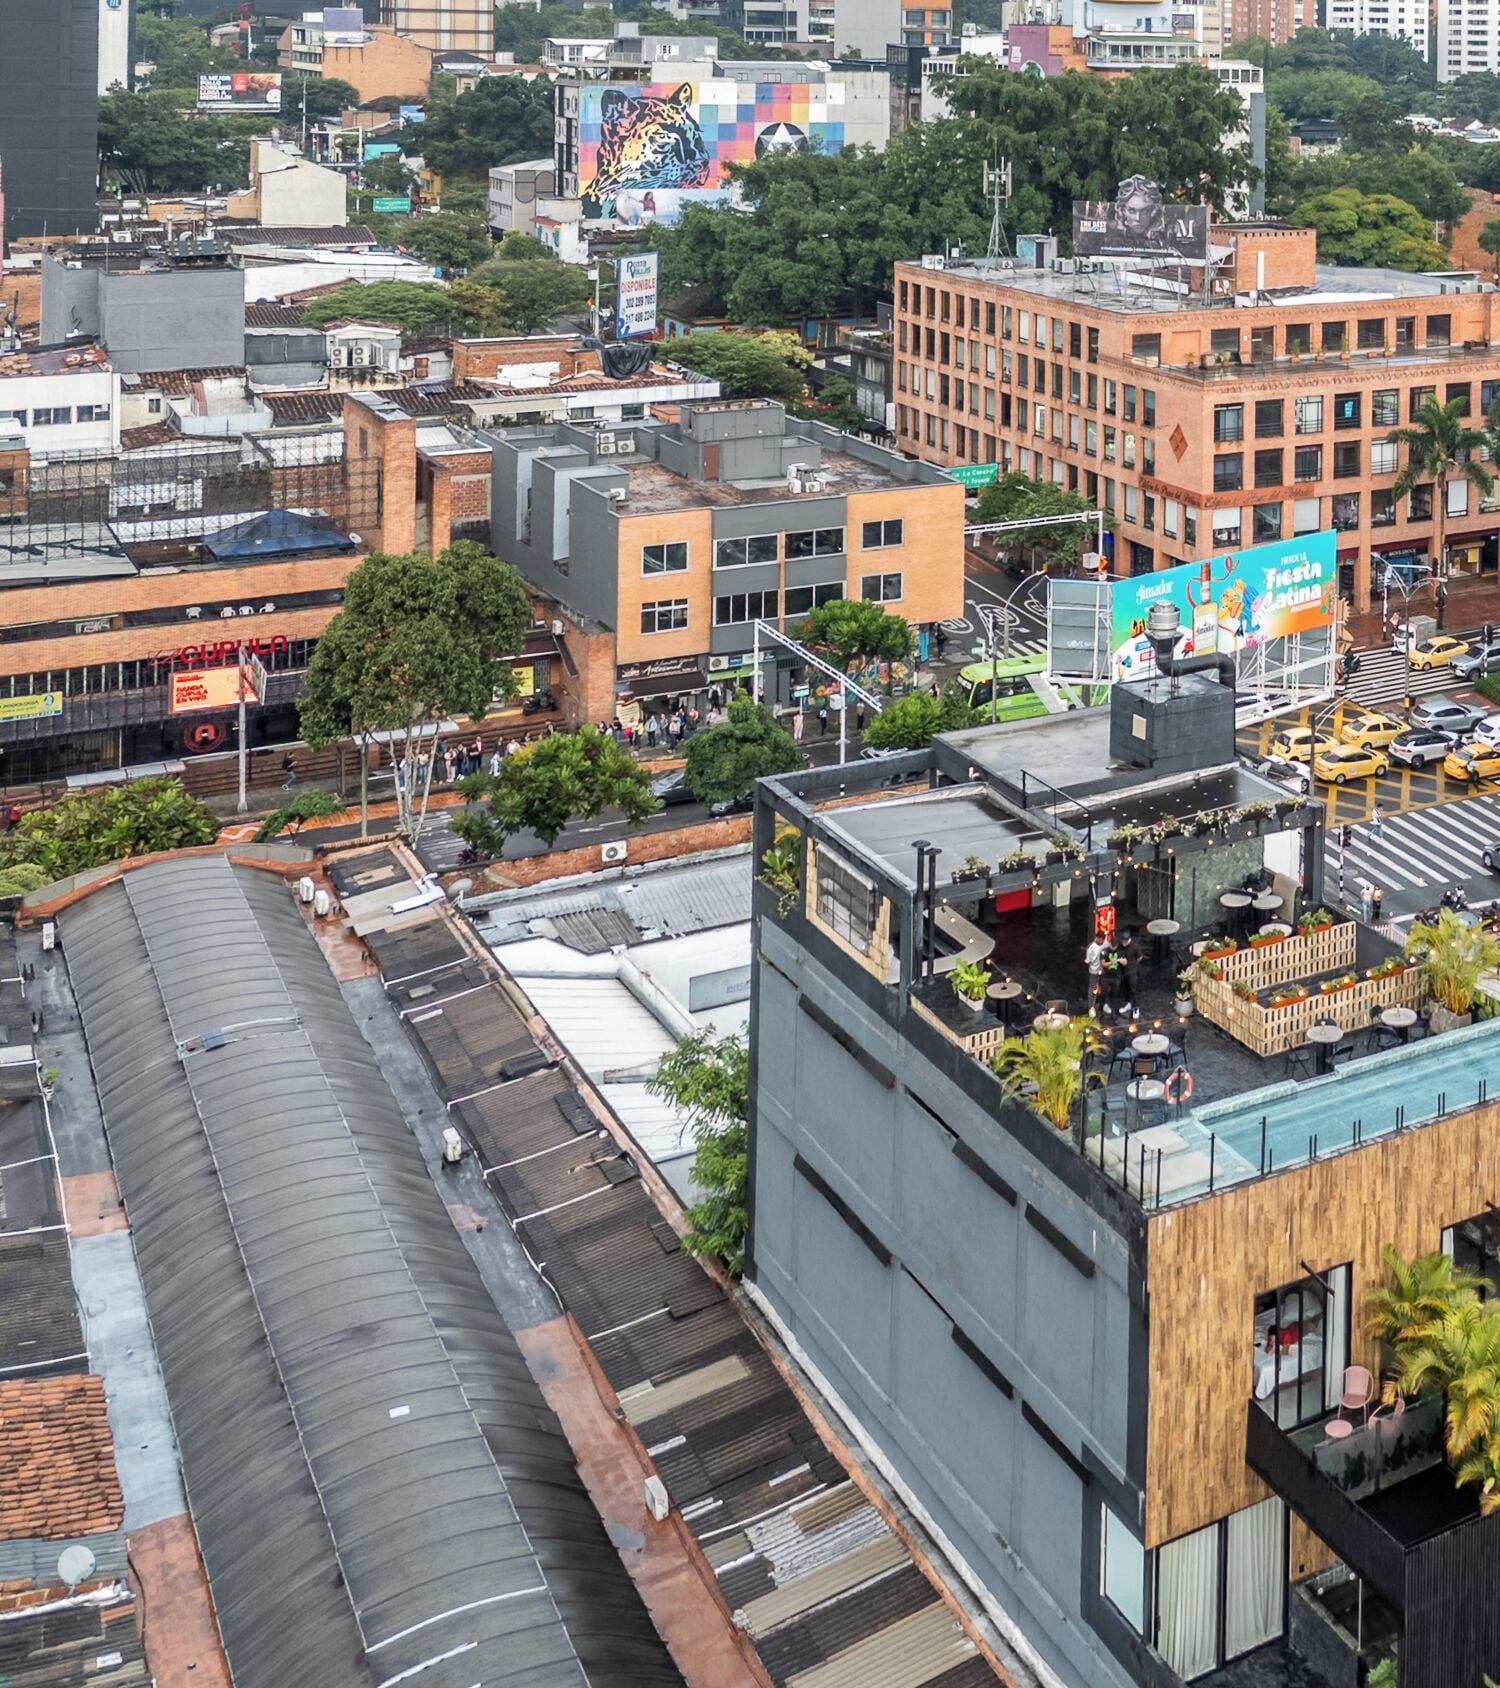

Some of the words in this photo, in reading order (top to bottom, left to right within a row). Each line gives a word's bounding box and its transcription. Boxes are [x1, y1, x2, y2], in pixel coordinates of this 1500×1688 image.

[621, 278, 655, 293] DISPONIBLE
[1262, 560, 1322, 590] Fiesta
[1265, 583, 1322, 611] Latina
